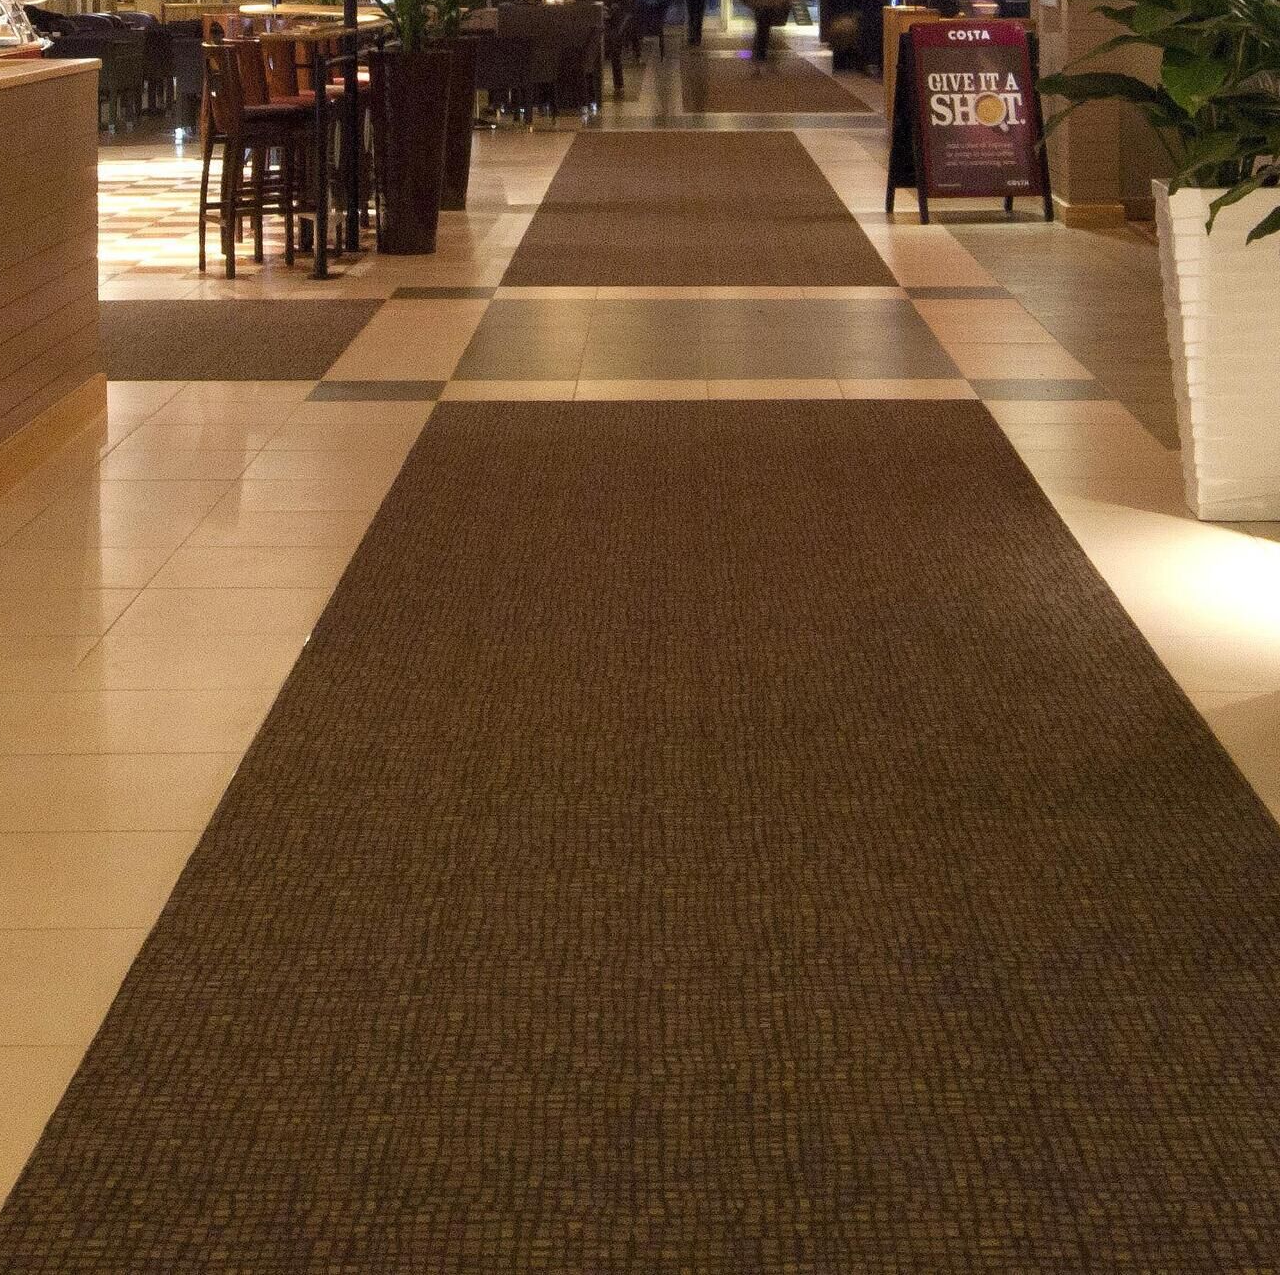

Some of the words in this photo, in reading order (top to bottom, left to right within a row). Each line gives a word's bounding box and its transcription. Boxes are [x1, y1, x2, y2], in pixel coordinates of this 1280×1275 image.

[947, 30, 991, 41] COSTA
[928, 72, 975, 91] GIVE
[979, 72, 999, 91] IT
[1005, 72, 1019, 90] A
